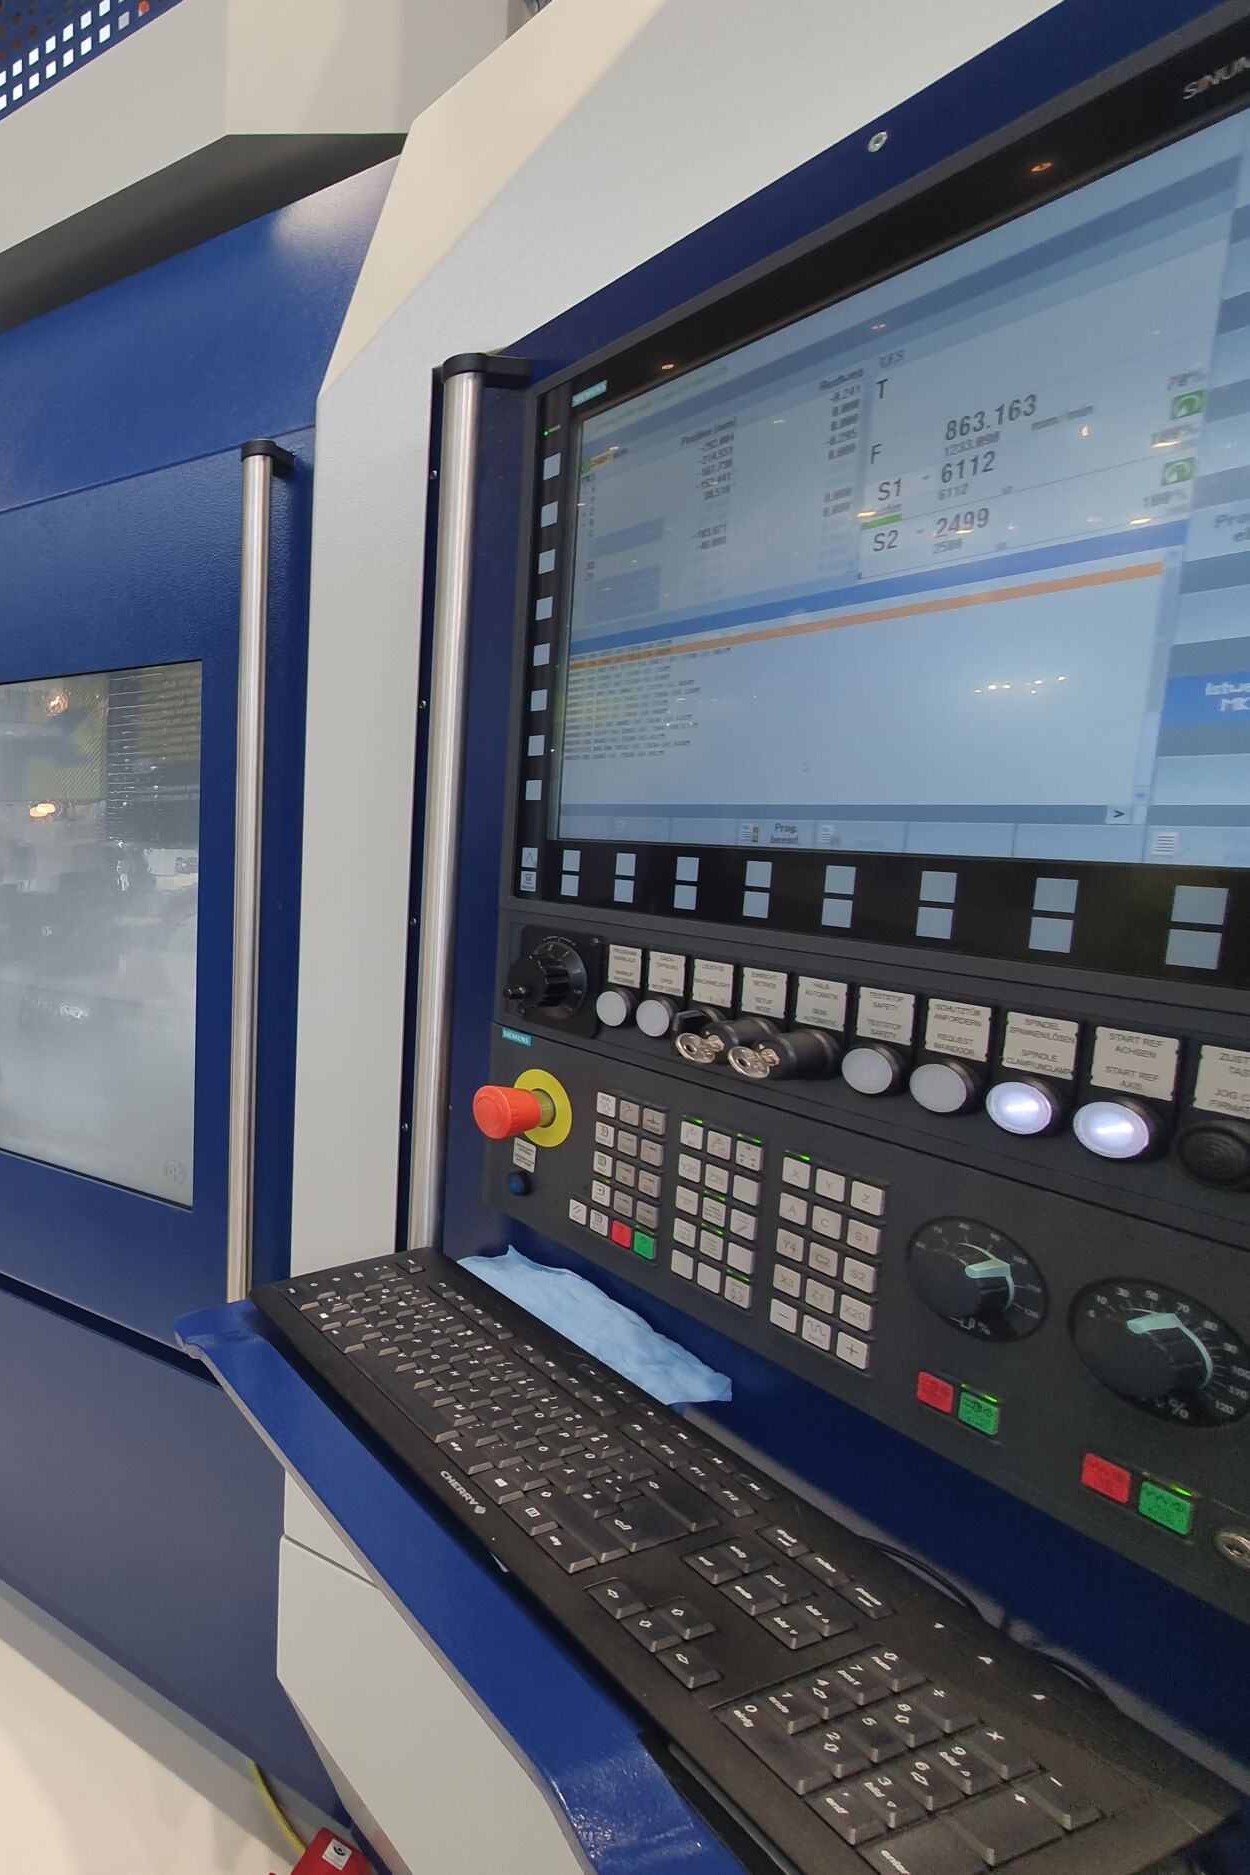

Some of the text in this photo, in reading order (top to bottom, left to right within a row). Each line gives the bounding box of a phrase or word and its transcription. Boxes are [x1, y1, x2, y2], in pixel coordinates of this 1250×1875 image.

[876, 379, 888, 399] T
[945, 394, 1037, 441] 863.163
[870, 443, 882, 464] F
[877, 451, 996, 501] S1 6112
[873, 530, 899, 552] S2
[933, 508, 989, 538] 2499
[873, 1001, 898, 1011] SAFETY
[502, 1028, 530, 1044] SIEMENS
[870, 1028, 896, 1039] SAFETY
[1108, 1032, 1164, 1048] START REF
[1105, 1065, 1159, 1082] START REF
[861, 1194, 871, 1205] Z
[820, 1217, 830, 1228] C
[854, 1231, 870, 1245] S1
[850, 1268, 865, 1282] S2
[440, 1469, 479, 1506] CHERRY
